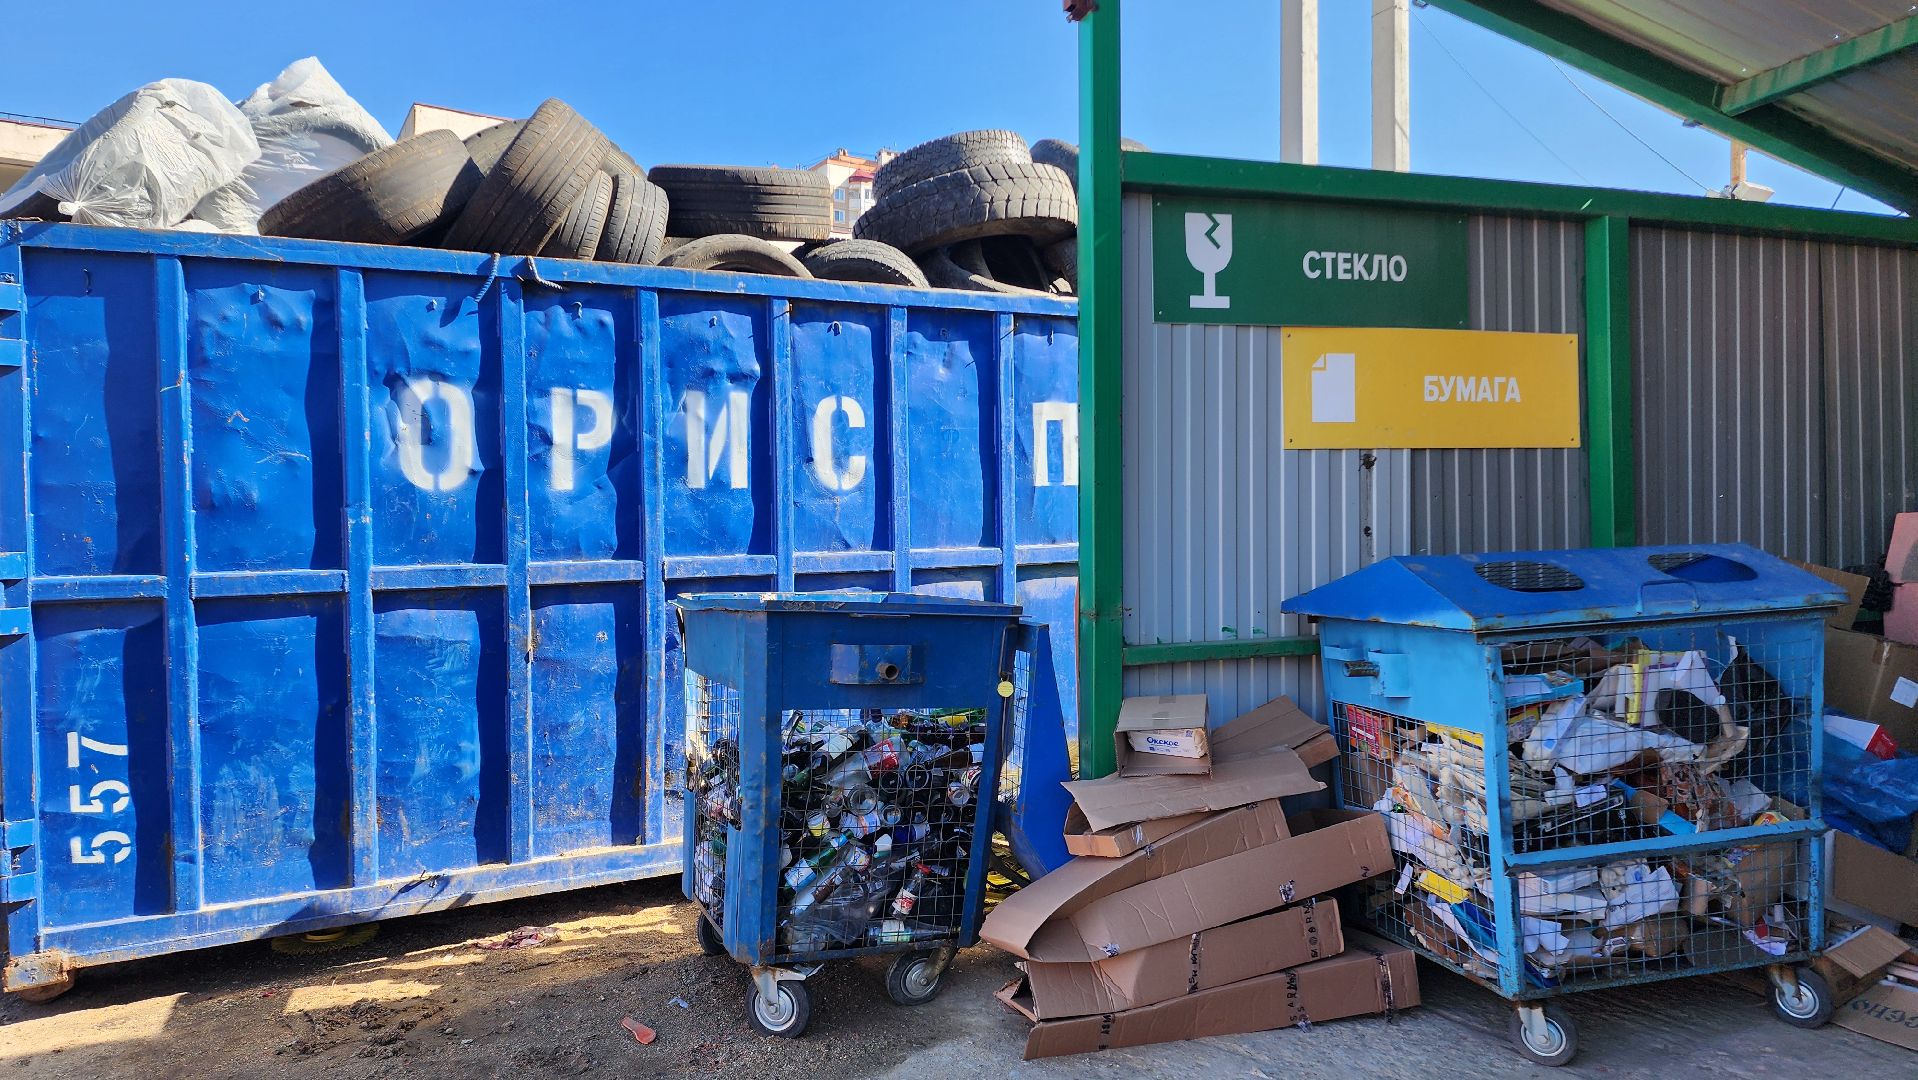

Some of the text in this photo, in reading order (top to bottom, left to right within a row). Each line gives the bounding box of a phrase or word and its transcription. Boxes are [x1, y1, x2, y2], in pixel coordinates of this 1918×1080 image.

[1302, 250, 1408, 283] СТЕКЛО
[1423, 375, 1521, 403] БУМАГА
[1146, 736, 1180, 747] Окское
[66, 731, 132, 864] 557
